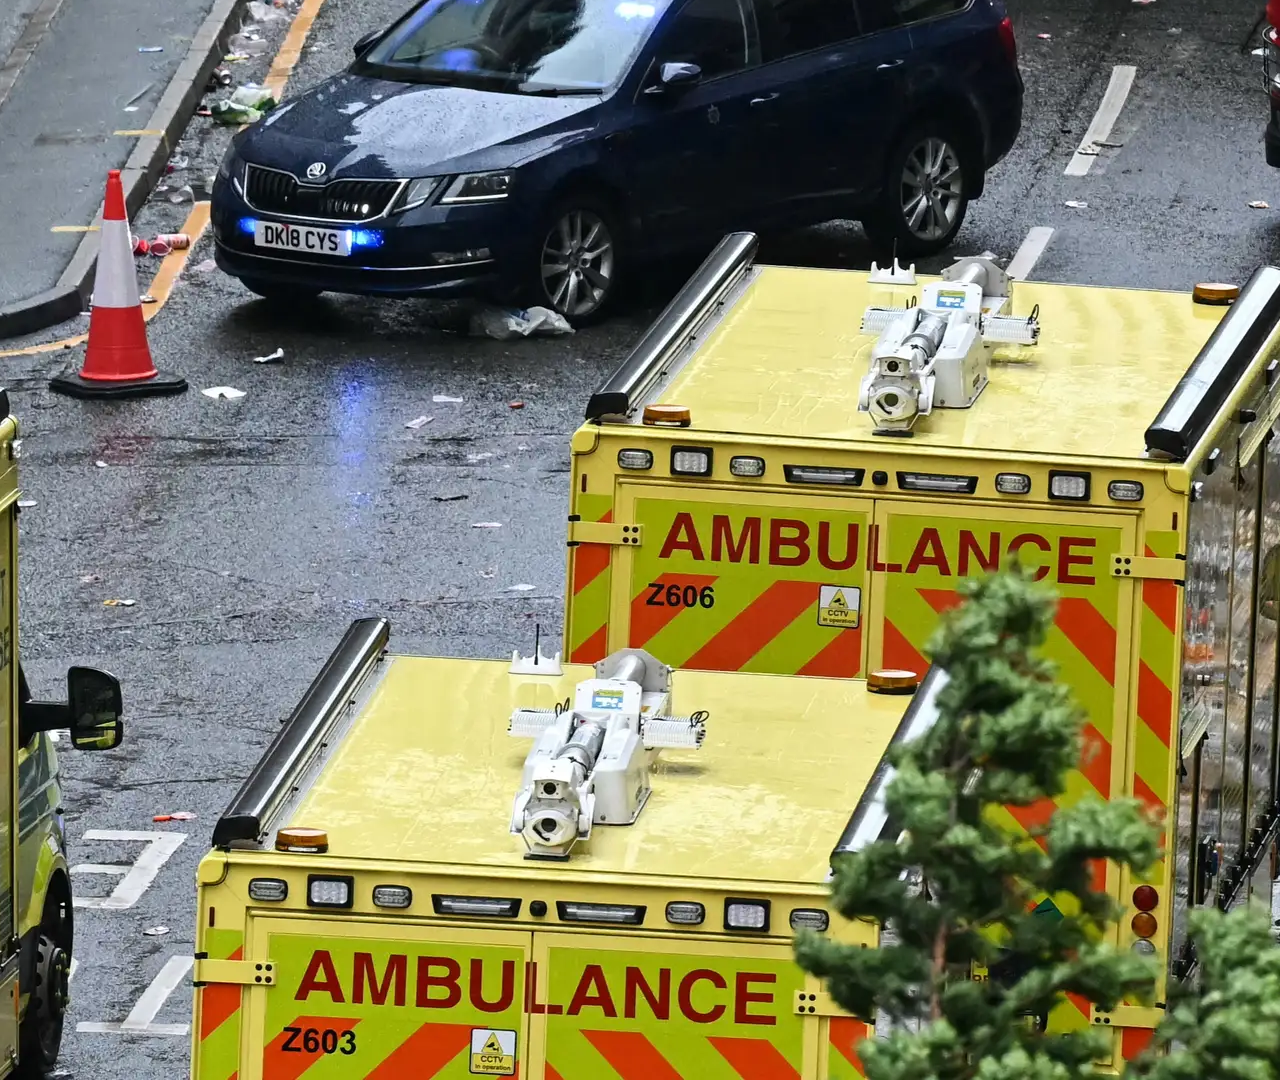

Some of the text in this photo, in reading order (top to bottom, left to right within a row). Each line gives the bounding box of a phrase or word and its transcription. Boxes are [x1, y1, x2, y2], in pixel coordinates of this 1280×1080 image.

[304, 229, 339, 252] CYS
[658, 511, 1097, 586] AMBULANCE
[645, 582, 716, 609] Z606
[827, 609, 849, 618] CCTV
[293, 948, 778, 1026] AMBULANCE
[280, 1025, 358, 1056] Z603
[480, 1055, 504, 1063] CCTV
